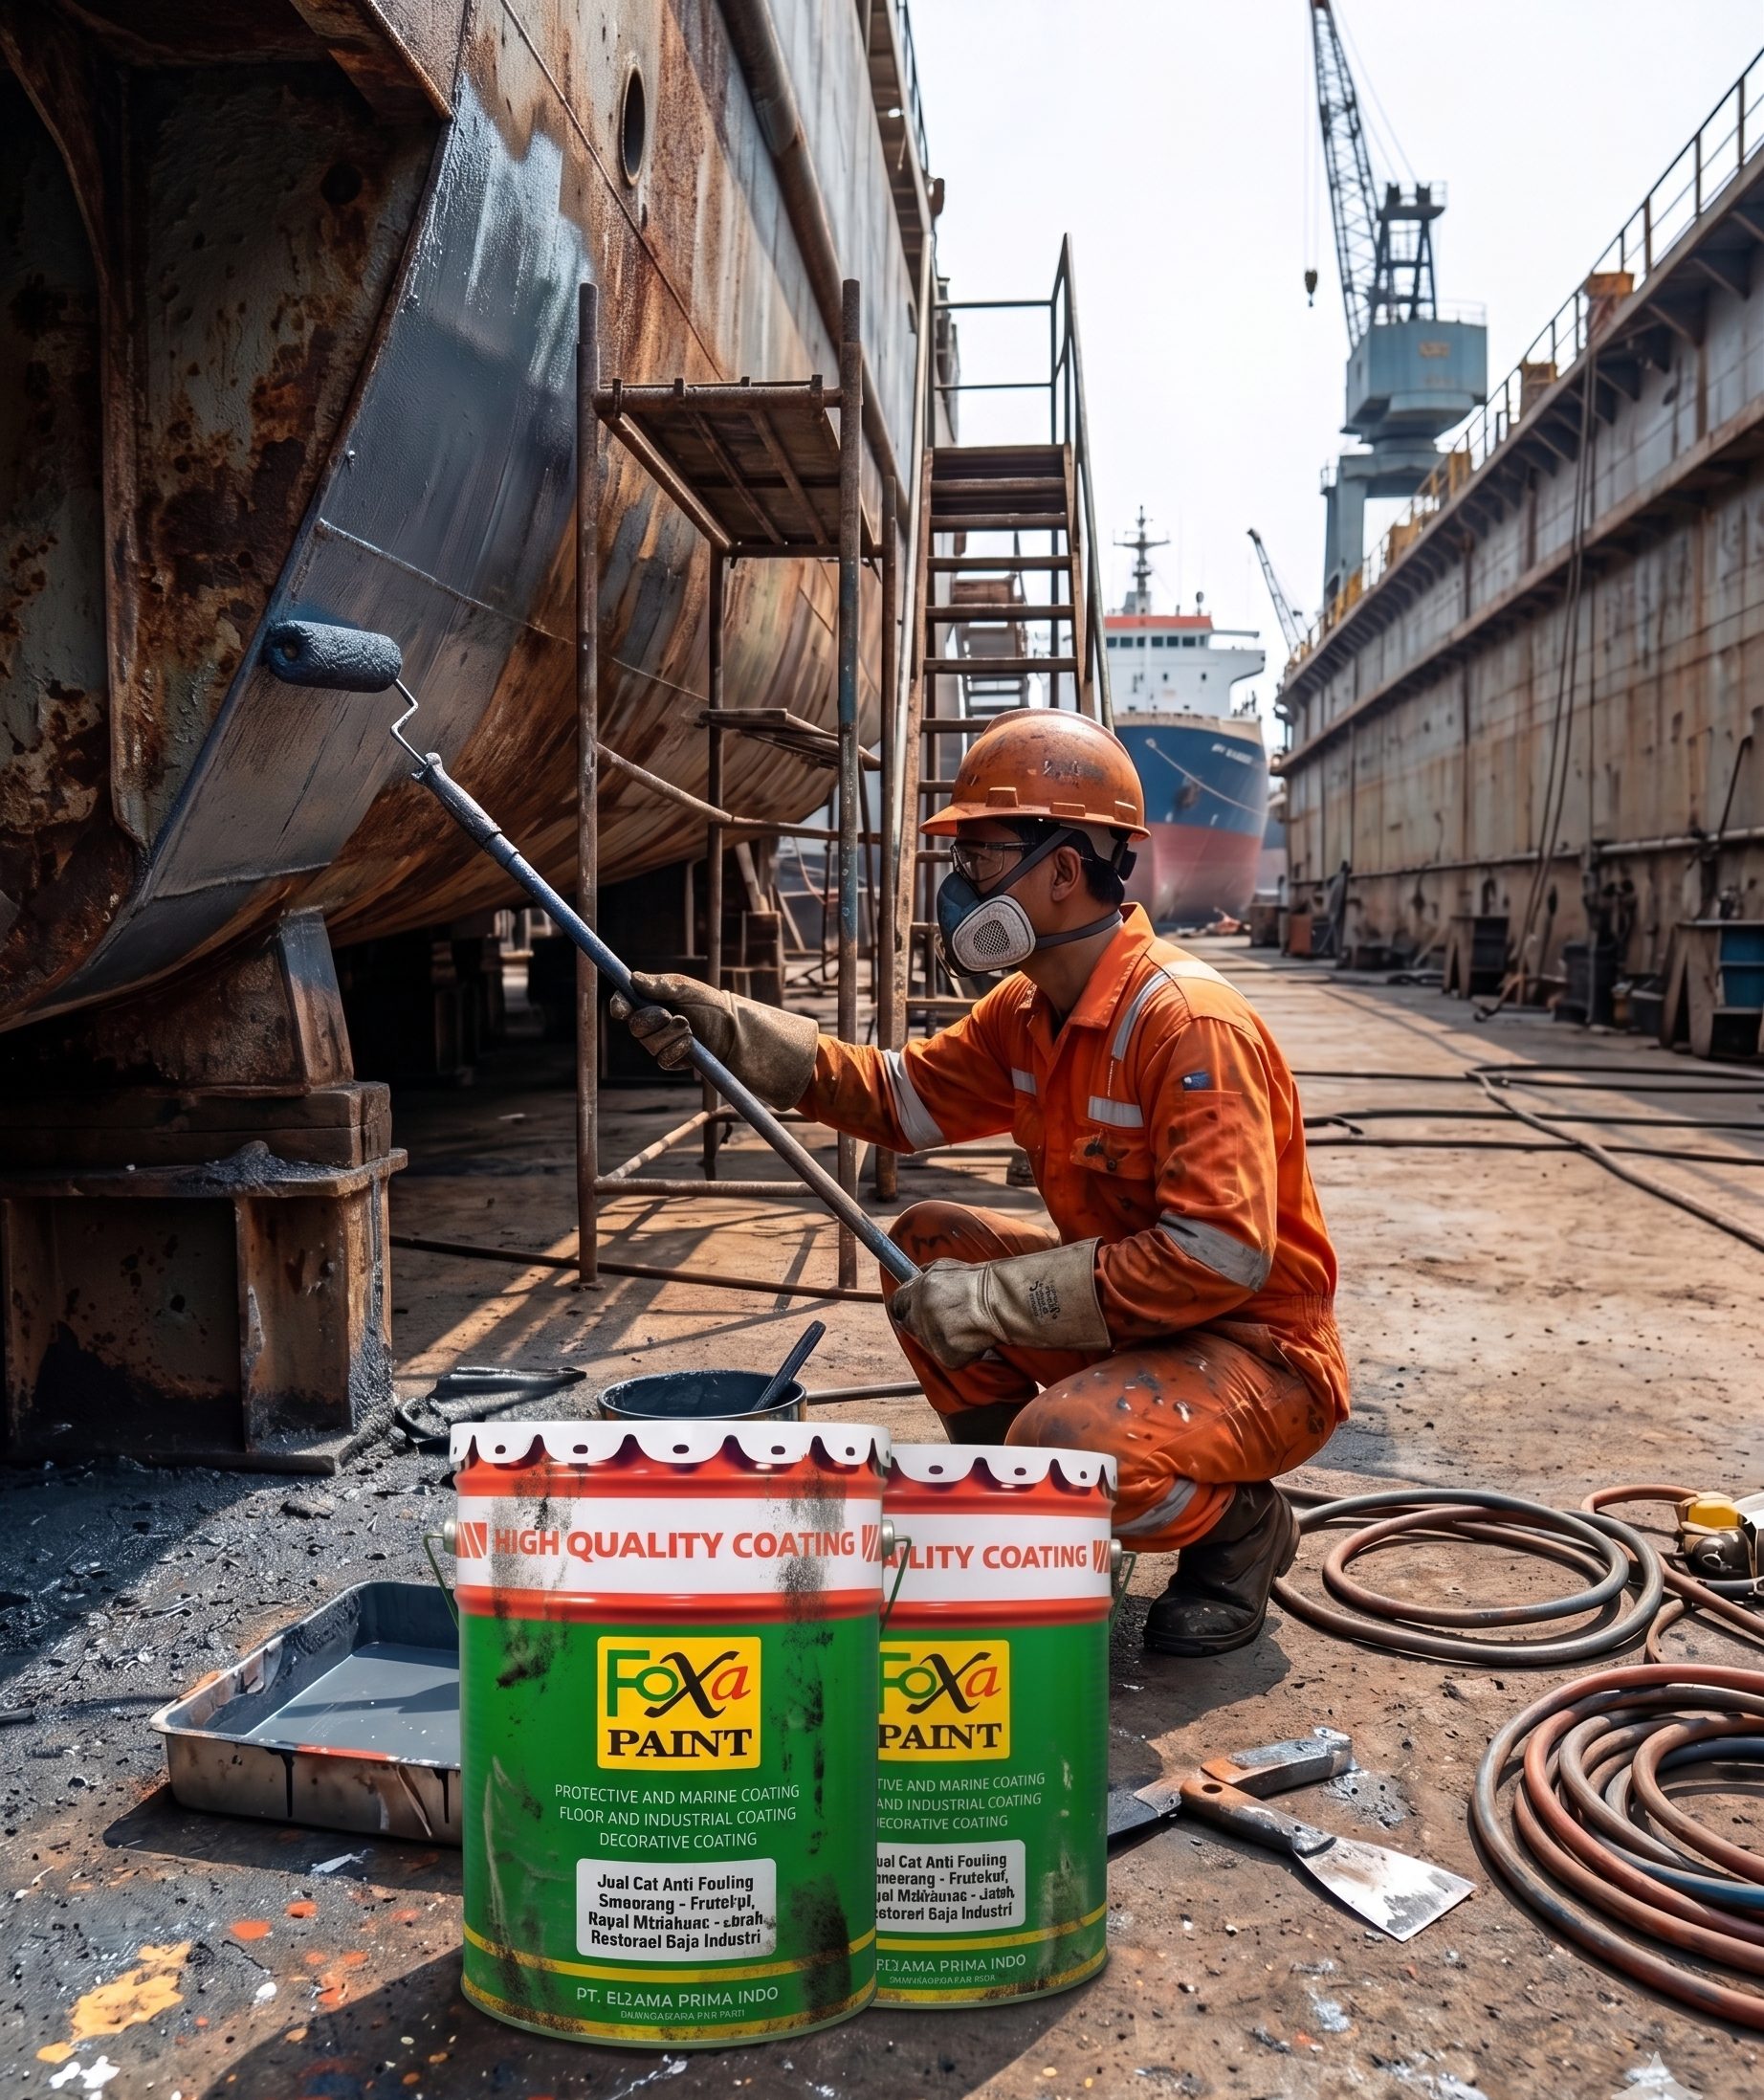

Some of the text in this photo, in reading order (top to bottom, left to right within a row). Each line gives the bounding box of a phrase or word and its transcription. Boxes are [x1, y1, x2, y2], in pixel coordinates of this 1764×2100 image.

[495, 1530, 855, 1562] HIGH QUALITY COATING
[982, 1545, 1087, 1568] COATING
[607, 1729, 753, 1757] PAINT
[879, 1723, 1002, 1750] PAINT
[907, 1779, 936, 1792] AND
[939, 1778, 989, 1792] MARINE
[993, 1773, 1045, 1789] COATING
[555, 1784, 800, 1804] PROTECTIVE AND MARINE COATING
[877, 1793, 1041, 1812] AND INDUSTRIAL COATING
[560, 1806, 796, 1827] FLOOR AND INDUSTRIAL COATING
[953, 1815, 1008, 1829] COATING
[600, 1832, 757, 1849] DECORATIVE COATING
[899, 1855, 922, 1868] Cat
[926, 1855, 953, 1868] Anti
[597, 1874, 754, 1891] Jual Cat Anti Fouling
[962, 1902, 1012, 1919] Industri
[704, 1930, 761, 1948] Industri
[940, 1959, 987, 1973] PRIMA
[991, 1954, 1026, 1970] INDO
[577, 1987, 601, 2003] PT.
[678, 1992, 734, 2007] PRIMA
[739, 1987, 779, 2004] INDO
